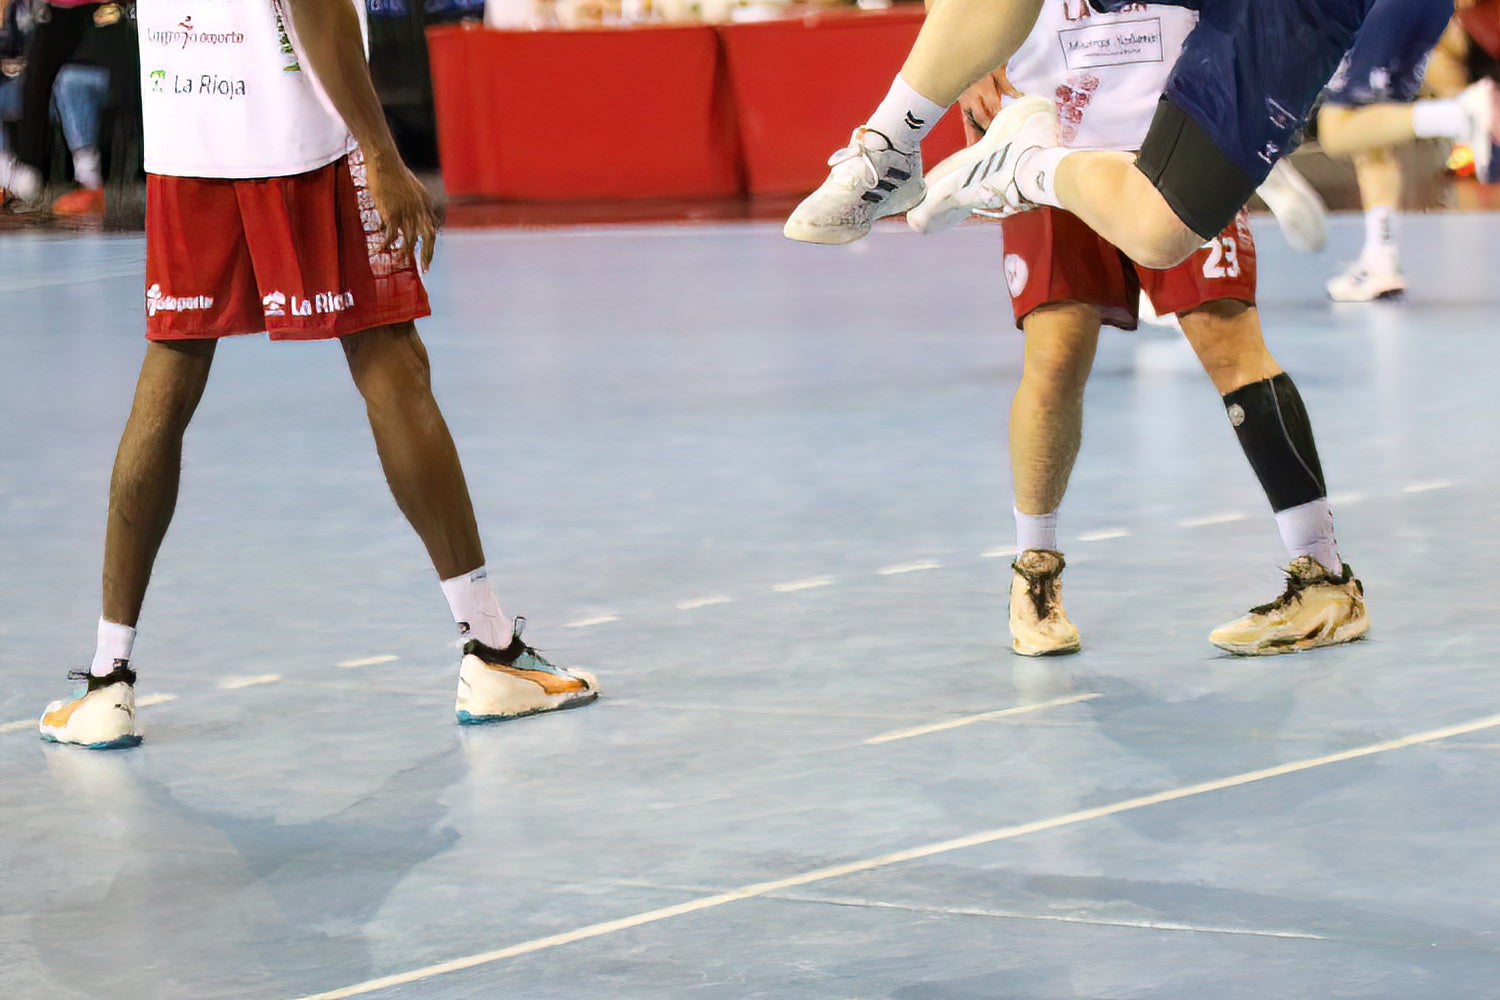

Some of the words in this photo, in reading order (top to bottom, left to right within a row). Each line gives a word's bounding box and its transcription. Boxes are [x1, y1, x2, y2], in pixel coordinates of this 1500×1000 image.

[174, 74, 193, 93] La
[198, 74, 246, 100] Rioja
[1202, 236, 1241, 278] 23
